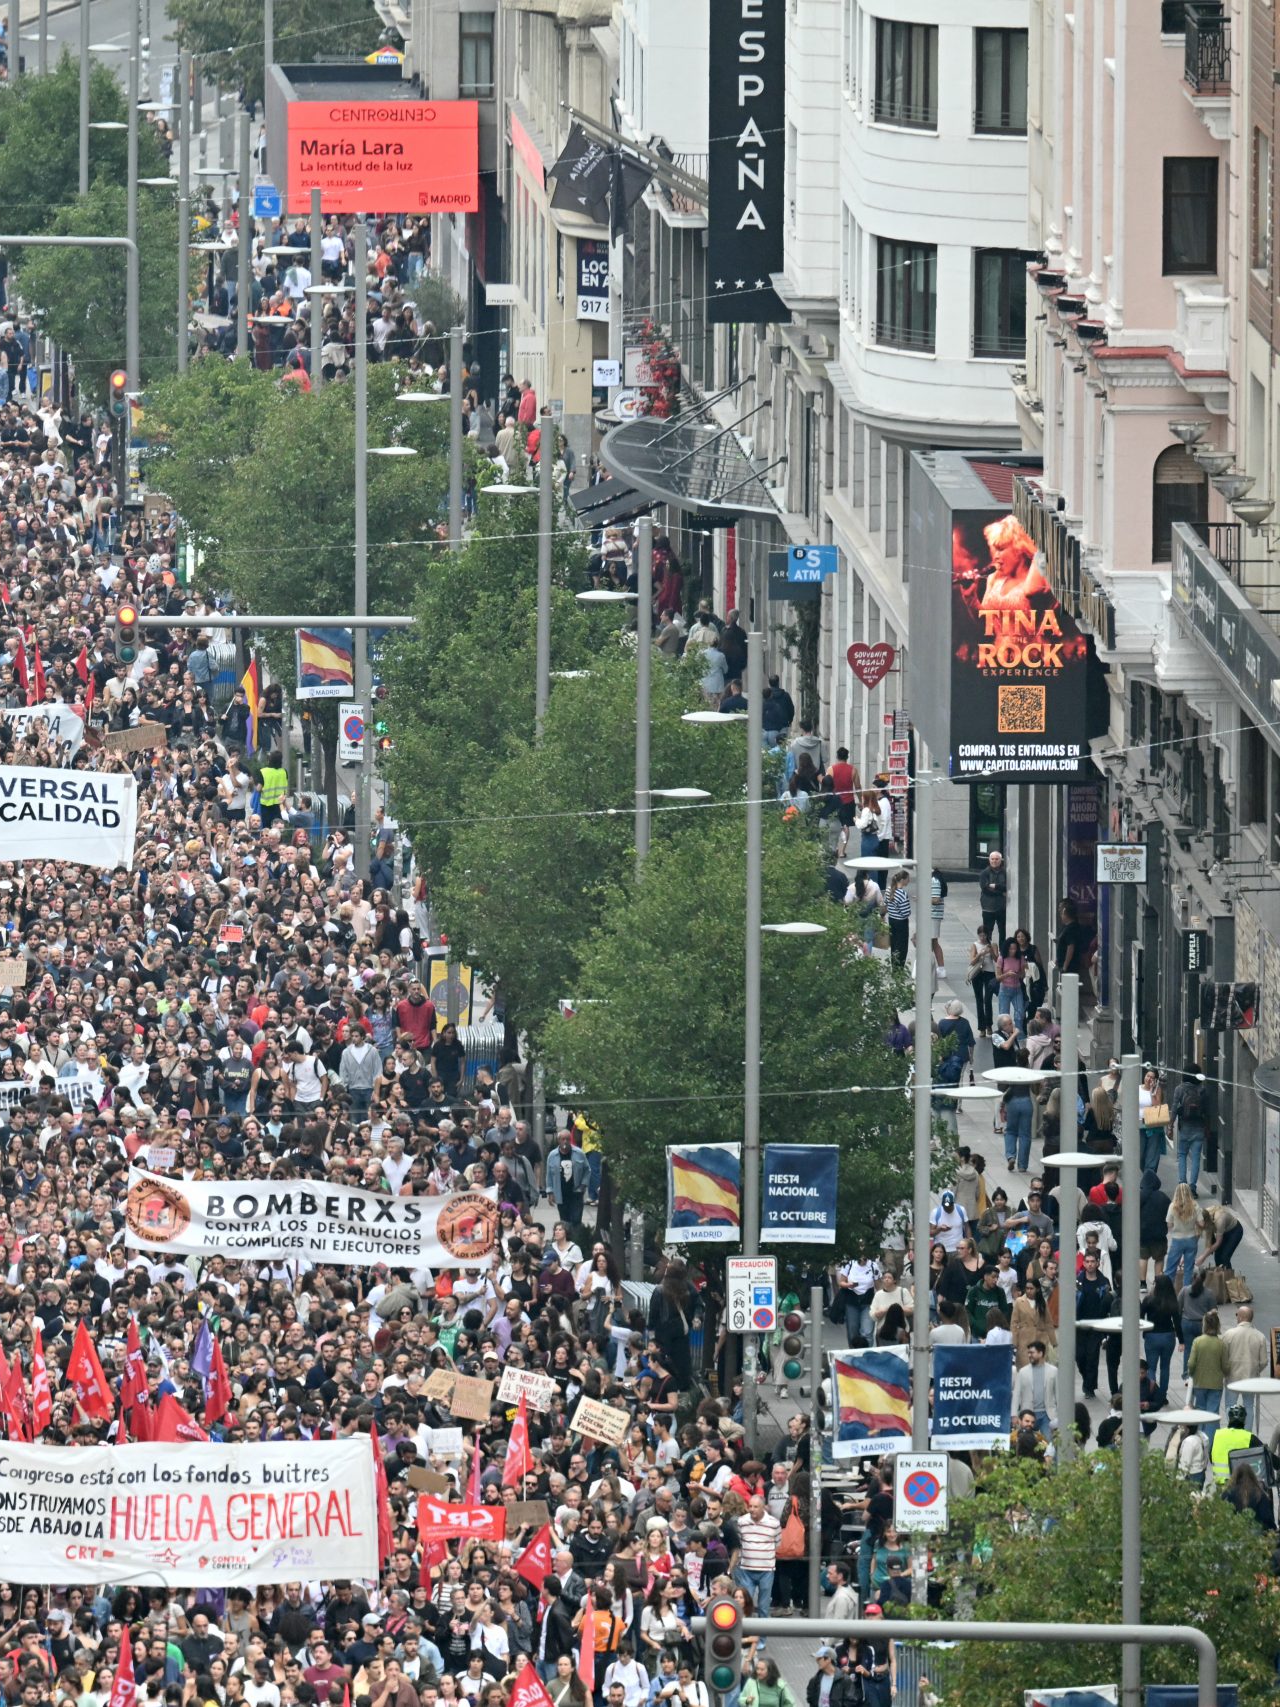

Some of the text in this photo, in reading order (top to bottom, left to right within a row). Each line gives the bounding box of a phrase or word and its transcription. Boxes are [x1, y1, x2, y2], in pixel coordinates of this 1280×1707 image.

[300, 139, 404, 156] María Lara
[300, 161, 413, 171] La lentitud de la luz
[430, 195, 471, 206] MADRID
[582, 260, 609, 272] LOC
[582, 274, 599, 287] EN
[582, 300, 601, 313] 917
[806, 550, 821, 567] S
[794, 570, 821, 581] ATM
[977, 609, 1063, 636] TINA
[976, 643, 1064, 668] ROCK
[958, 744, 1080, 757] COMPRA TUS ENTRADAS EN
[959, 759, 1079, 771] WWW.CAPITOLGRANVIA.COM
[1071, 803, 1097, 812] AHORA
[0, 802, 121, 828] CALIDAD
[1071, 813, 1097, 822] MADRID
[1103, 857, 1141, 870] buffet
[1109, 866, 1135, 880] libre
[1071, 885, 1097, 900] SIX
[1188, 933, 1197, 970] TXAPELA
[769, 1174, 799, 1184] FIESTA
[769, 1186, 819, 1197] NACIONAL
[206, 1192, 422, 1224] BOMBERXS
[447, 1194, 495, 1214] BOMBERXS
[768, 1211, 827, 1224] 12 OCTUBRE
[205, 1220, 422, 1240] CONTRA LOS DESAHUCIOS
[691, 1230, 723, 1239] MADRID
[203, 1233, 421, 1255] NI CÓMPLICES NI EJECUTORES
[730, 1260, 773, 1268] PRECAUCIÓN
[939, 1377, 972, 1387] FIESTA
[939, 1389, 992, 1400] NACIONAL
[938, 1415, 1001, 1428] 12 OCTUBRE
[861, 1442, 895, 1451] MADRID
[80, 1467, 115, 1485] está
[117, 1469, 146, 1484] con
[185, 1464, 251, 1484] fondos
[263, 1463, 330, 1484] buitres
[109, 1492, 219, 1542] HUELGA
[226, 1488, 363, 1542] GENERAL
[30, 1517, 82, 1536] ABAJO
[85, 1521, 104, 1539] LA
[65, 1545, 98, 1560] CRT
[212, 1555, 247, 1563] CONTRA
